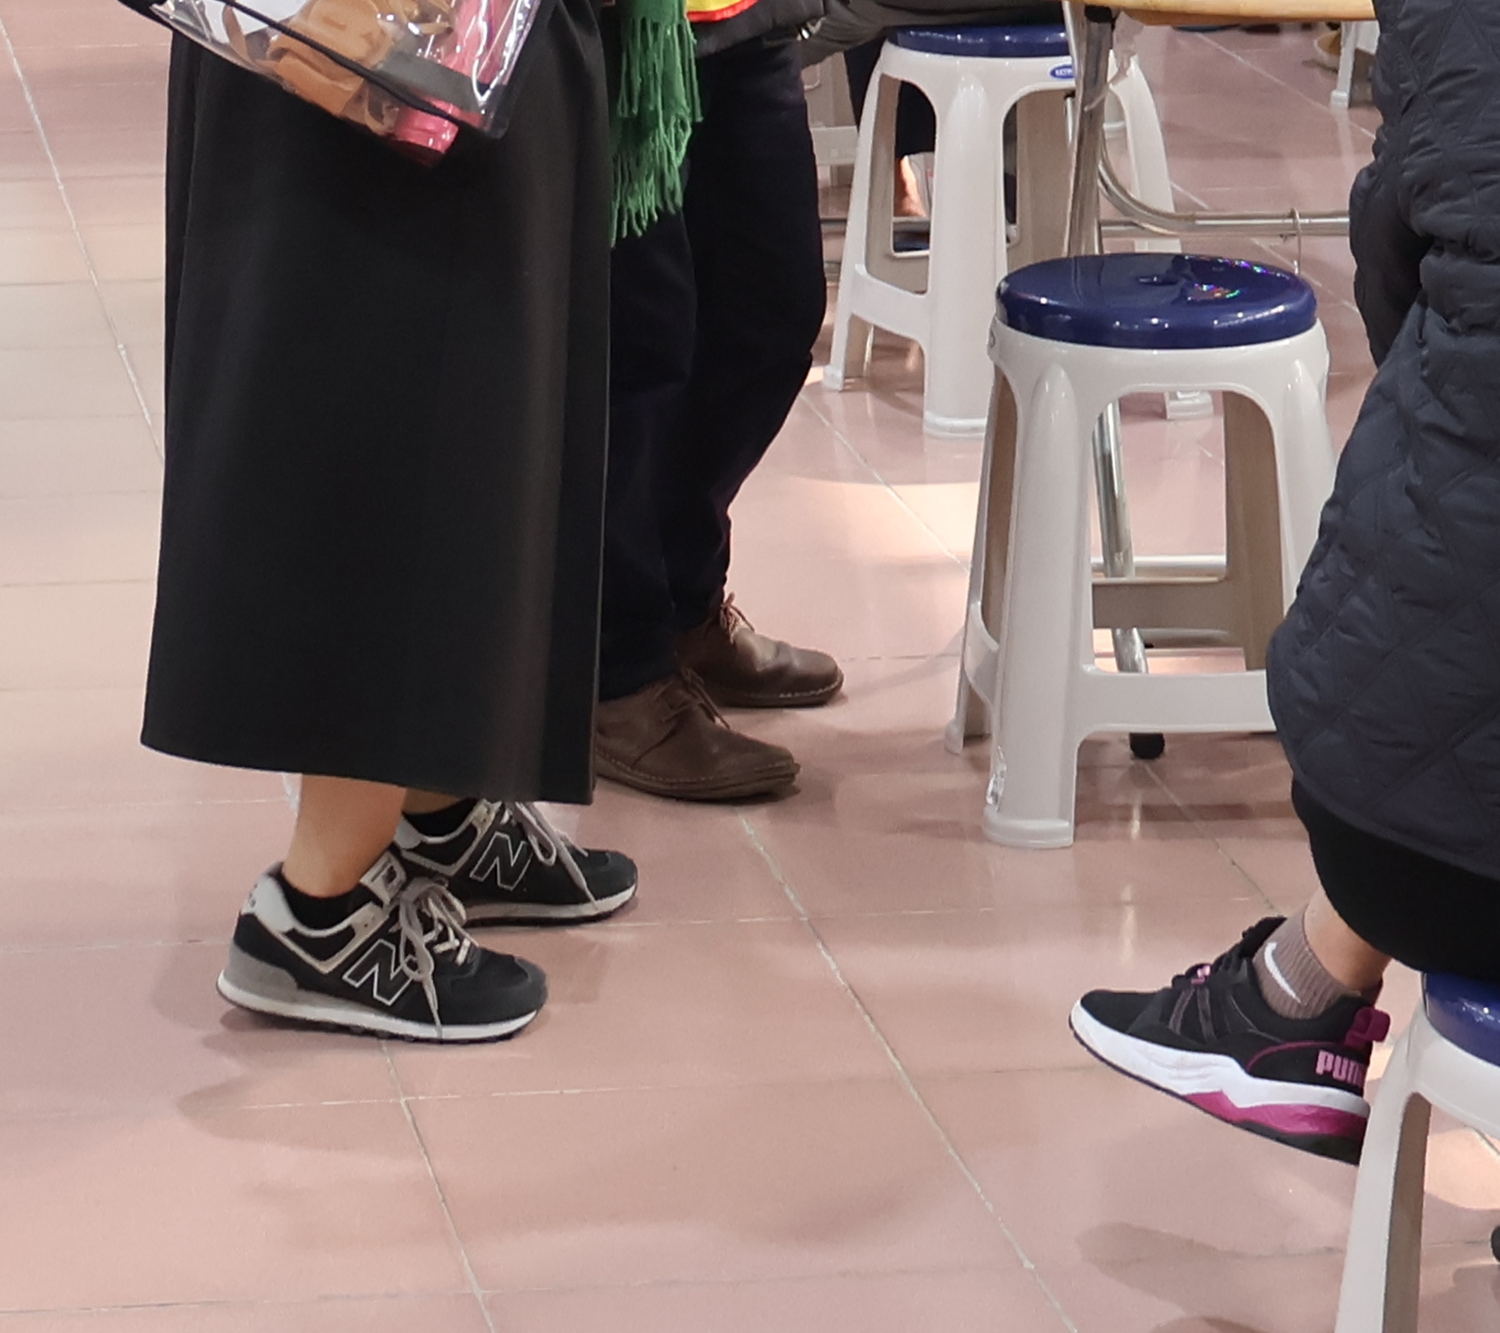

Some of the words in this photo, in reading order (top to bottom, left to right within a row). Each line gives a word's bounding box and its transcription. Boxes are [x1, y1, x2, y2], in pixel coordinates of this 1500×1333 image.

[469, 831, 533, 891] N
[342, 938, 418, 1006] N
[1315, 1048, 1365, 1087] PUM
